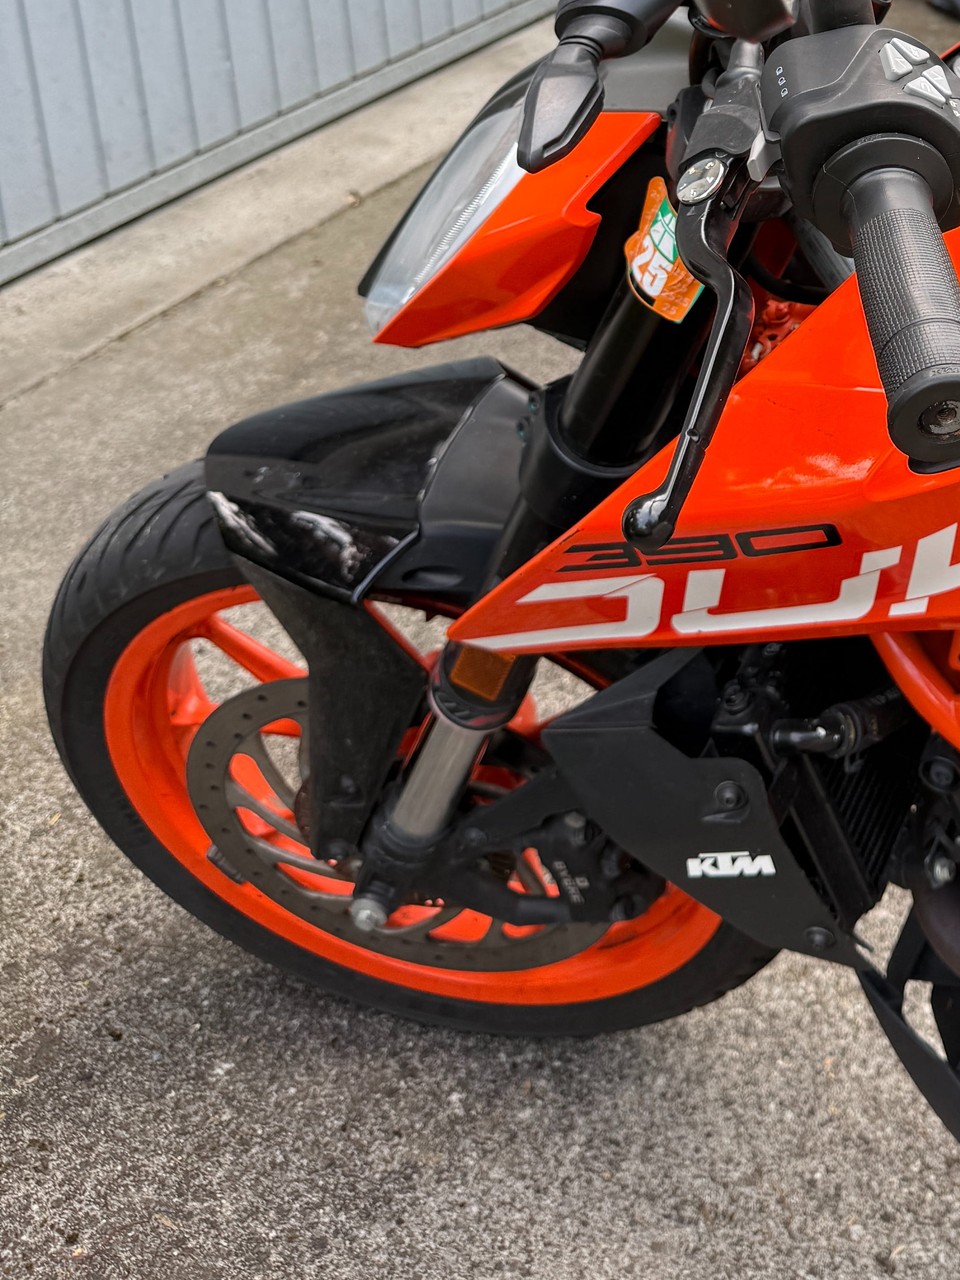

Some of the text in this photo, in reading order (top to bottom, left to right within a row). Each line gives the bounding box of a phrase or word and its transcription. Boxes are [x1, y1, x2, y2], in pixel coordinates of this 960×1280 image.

[632, 234, 673, 296] 25
[556, 524, 843, 572] 390
[686, 851, 776, 878] KTM
